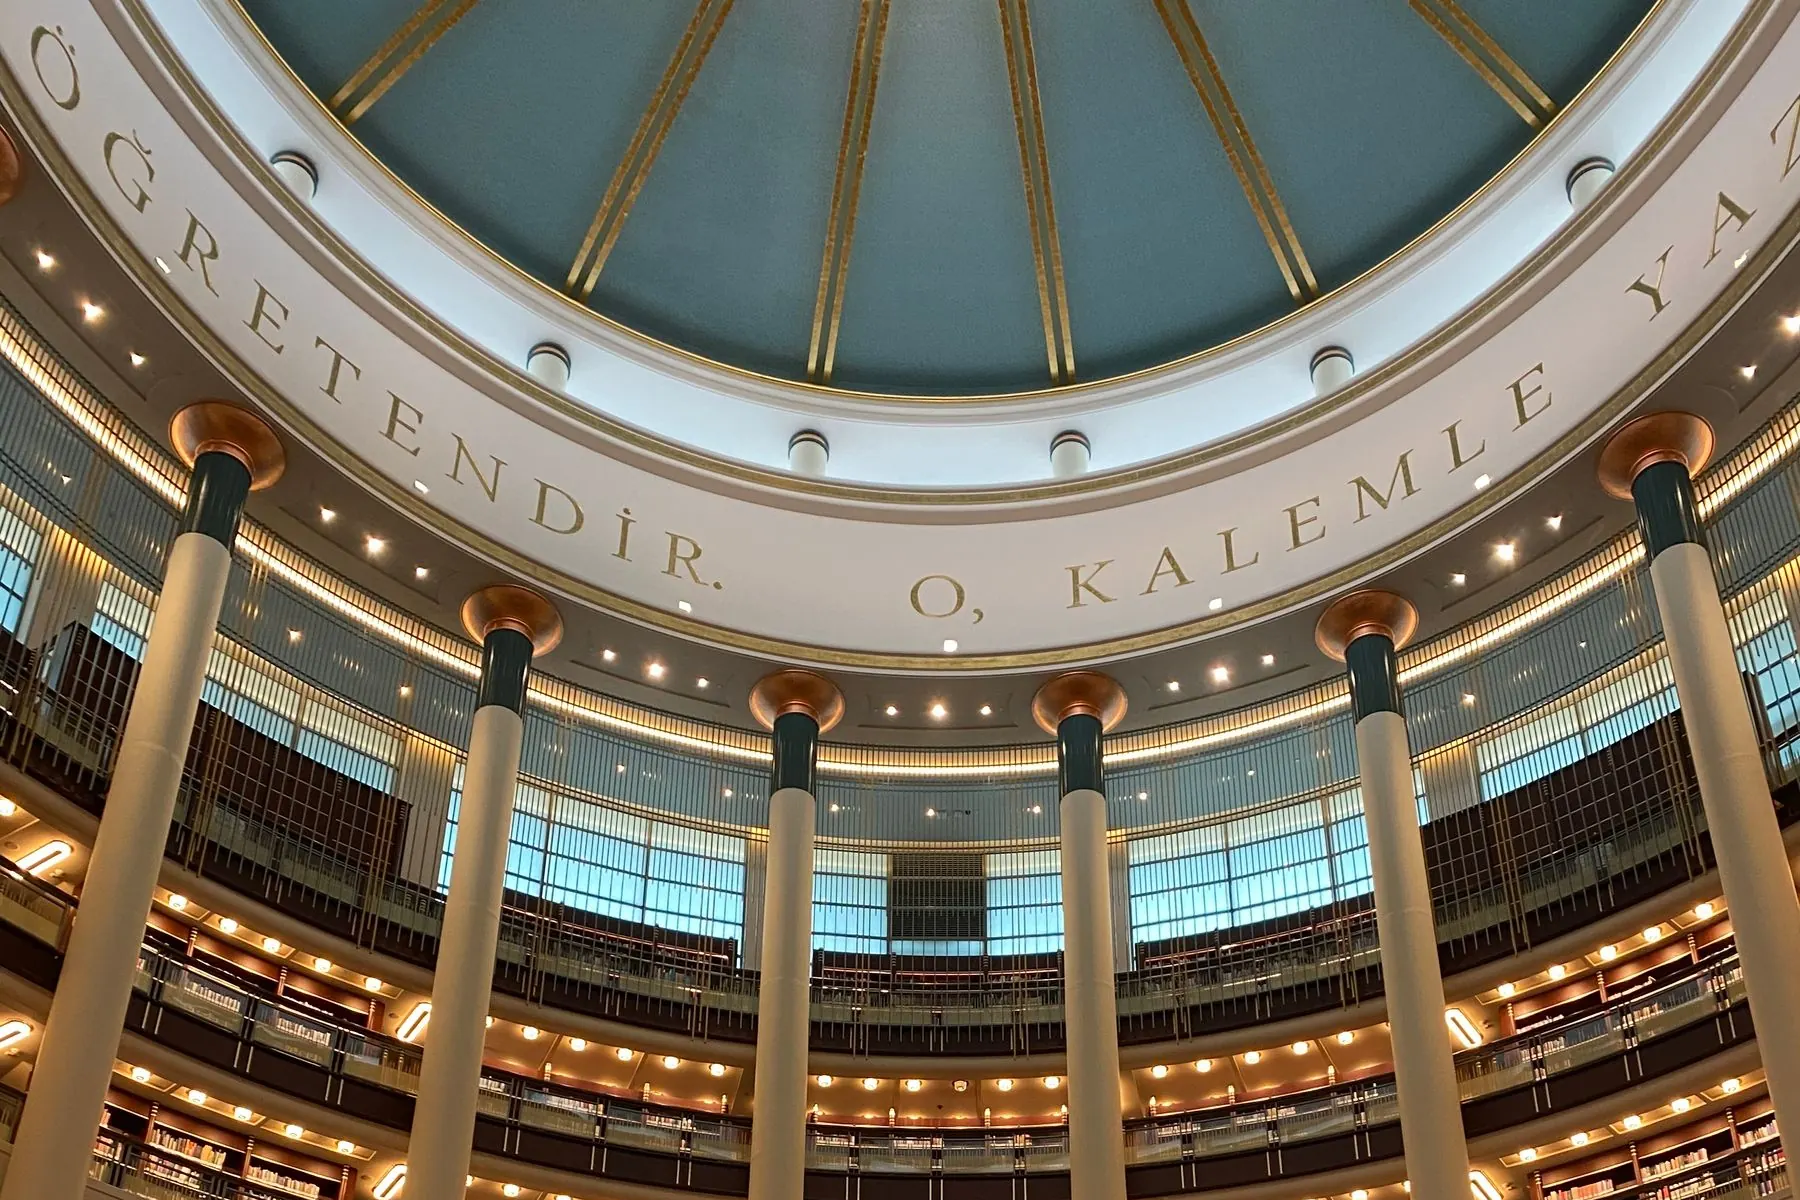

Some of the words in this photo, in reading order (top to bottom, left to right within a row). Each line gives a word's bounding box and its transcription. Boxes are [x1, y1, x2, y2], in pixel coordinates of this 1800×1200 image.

[30, 25, 723, 590] ÖĞRETENDİR.
[910, 574, 984, 625] O,
[1065, 361, 1553, 609] KALEMLE
